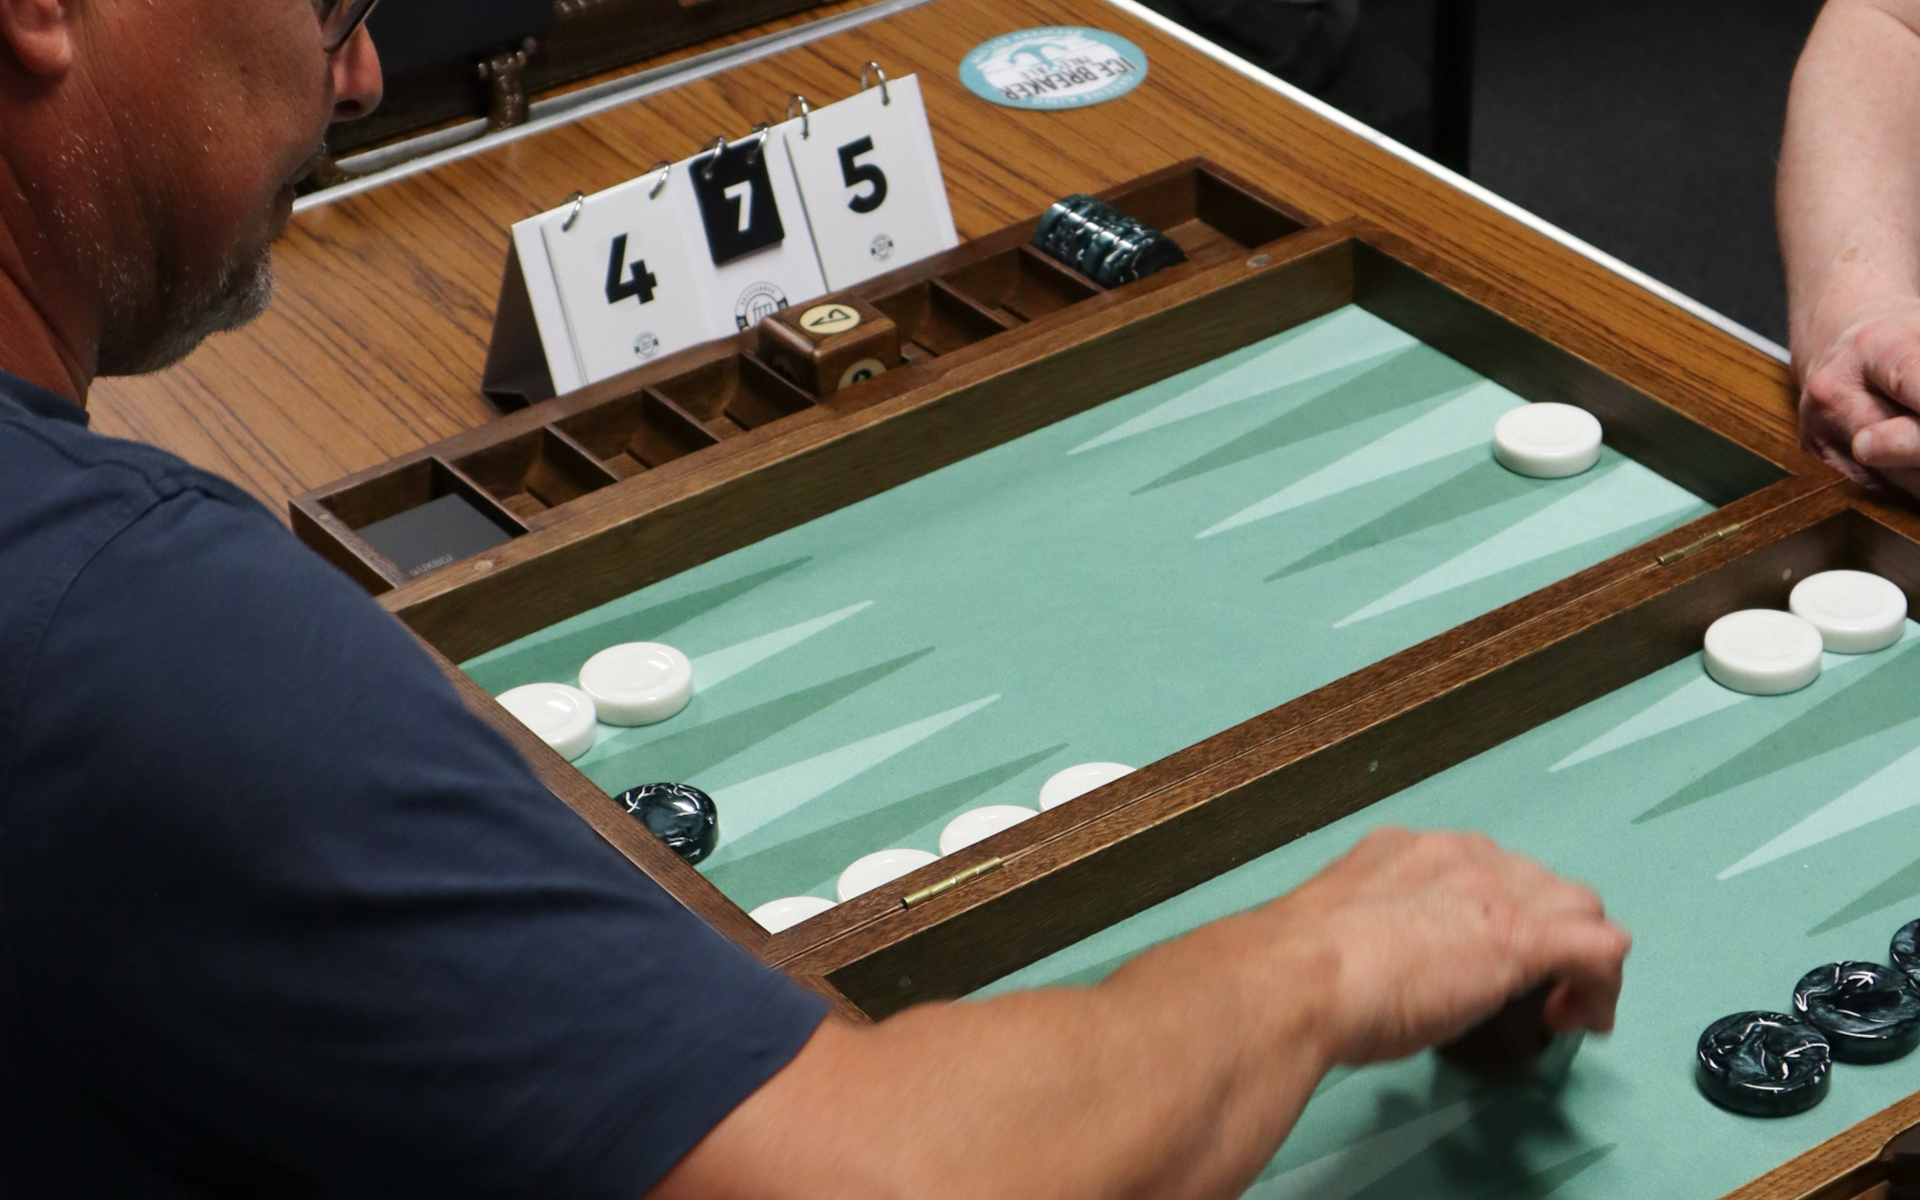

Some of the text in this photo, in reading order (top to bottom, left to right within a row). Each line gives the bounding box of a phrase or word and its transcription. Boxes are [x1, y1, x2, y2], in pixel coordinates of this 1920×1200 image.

[998, 57, 1138, 101] ICE BREAKER
[723, 180, 753, 233] 7
[837, 135, 889, 215] 5
[604, 232, 657, 305] 4
